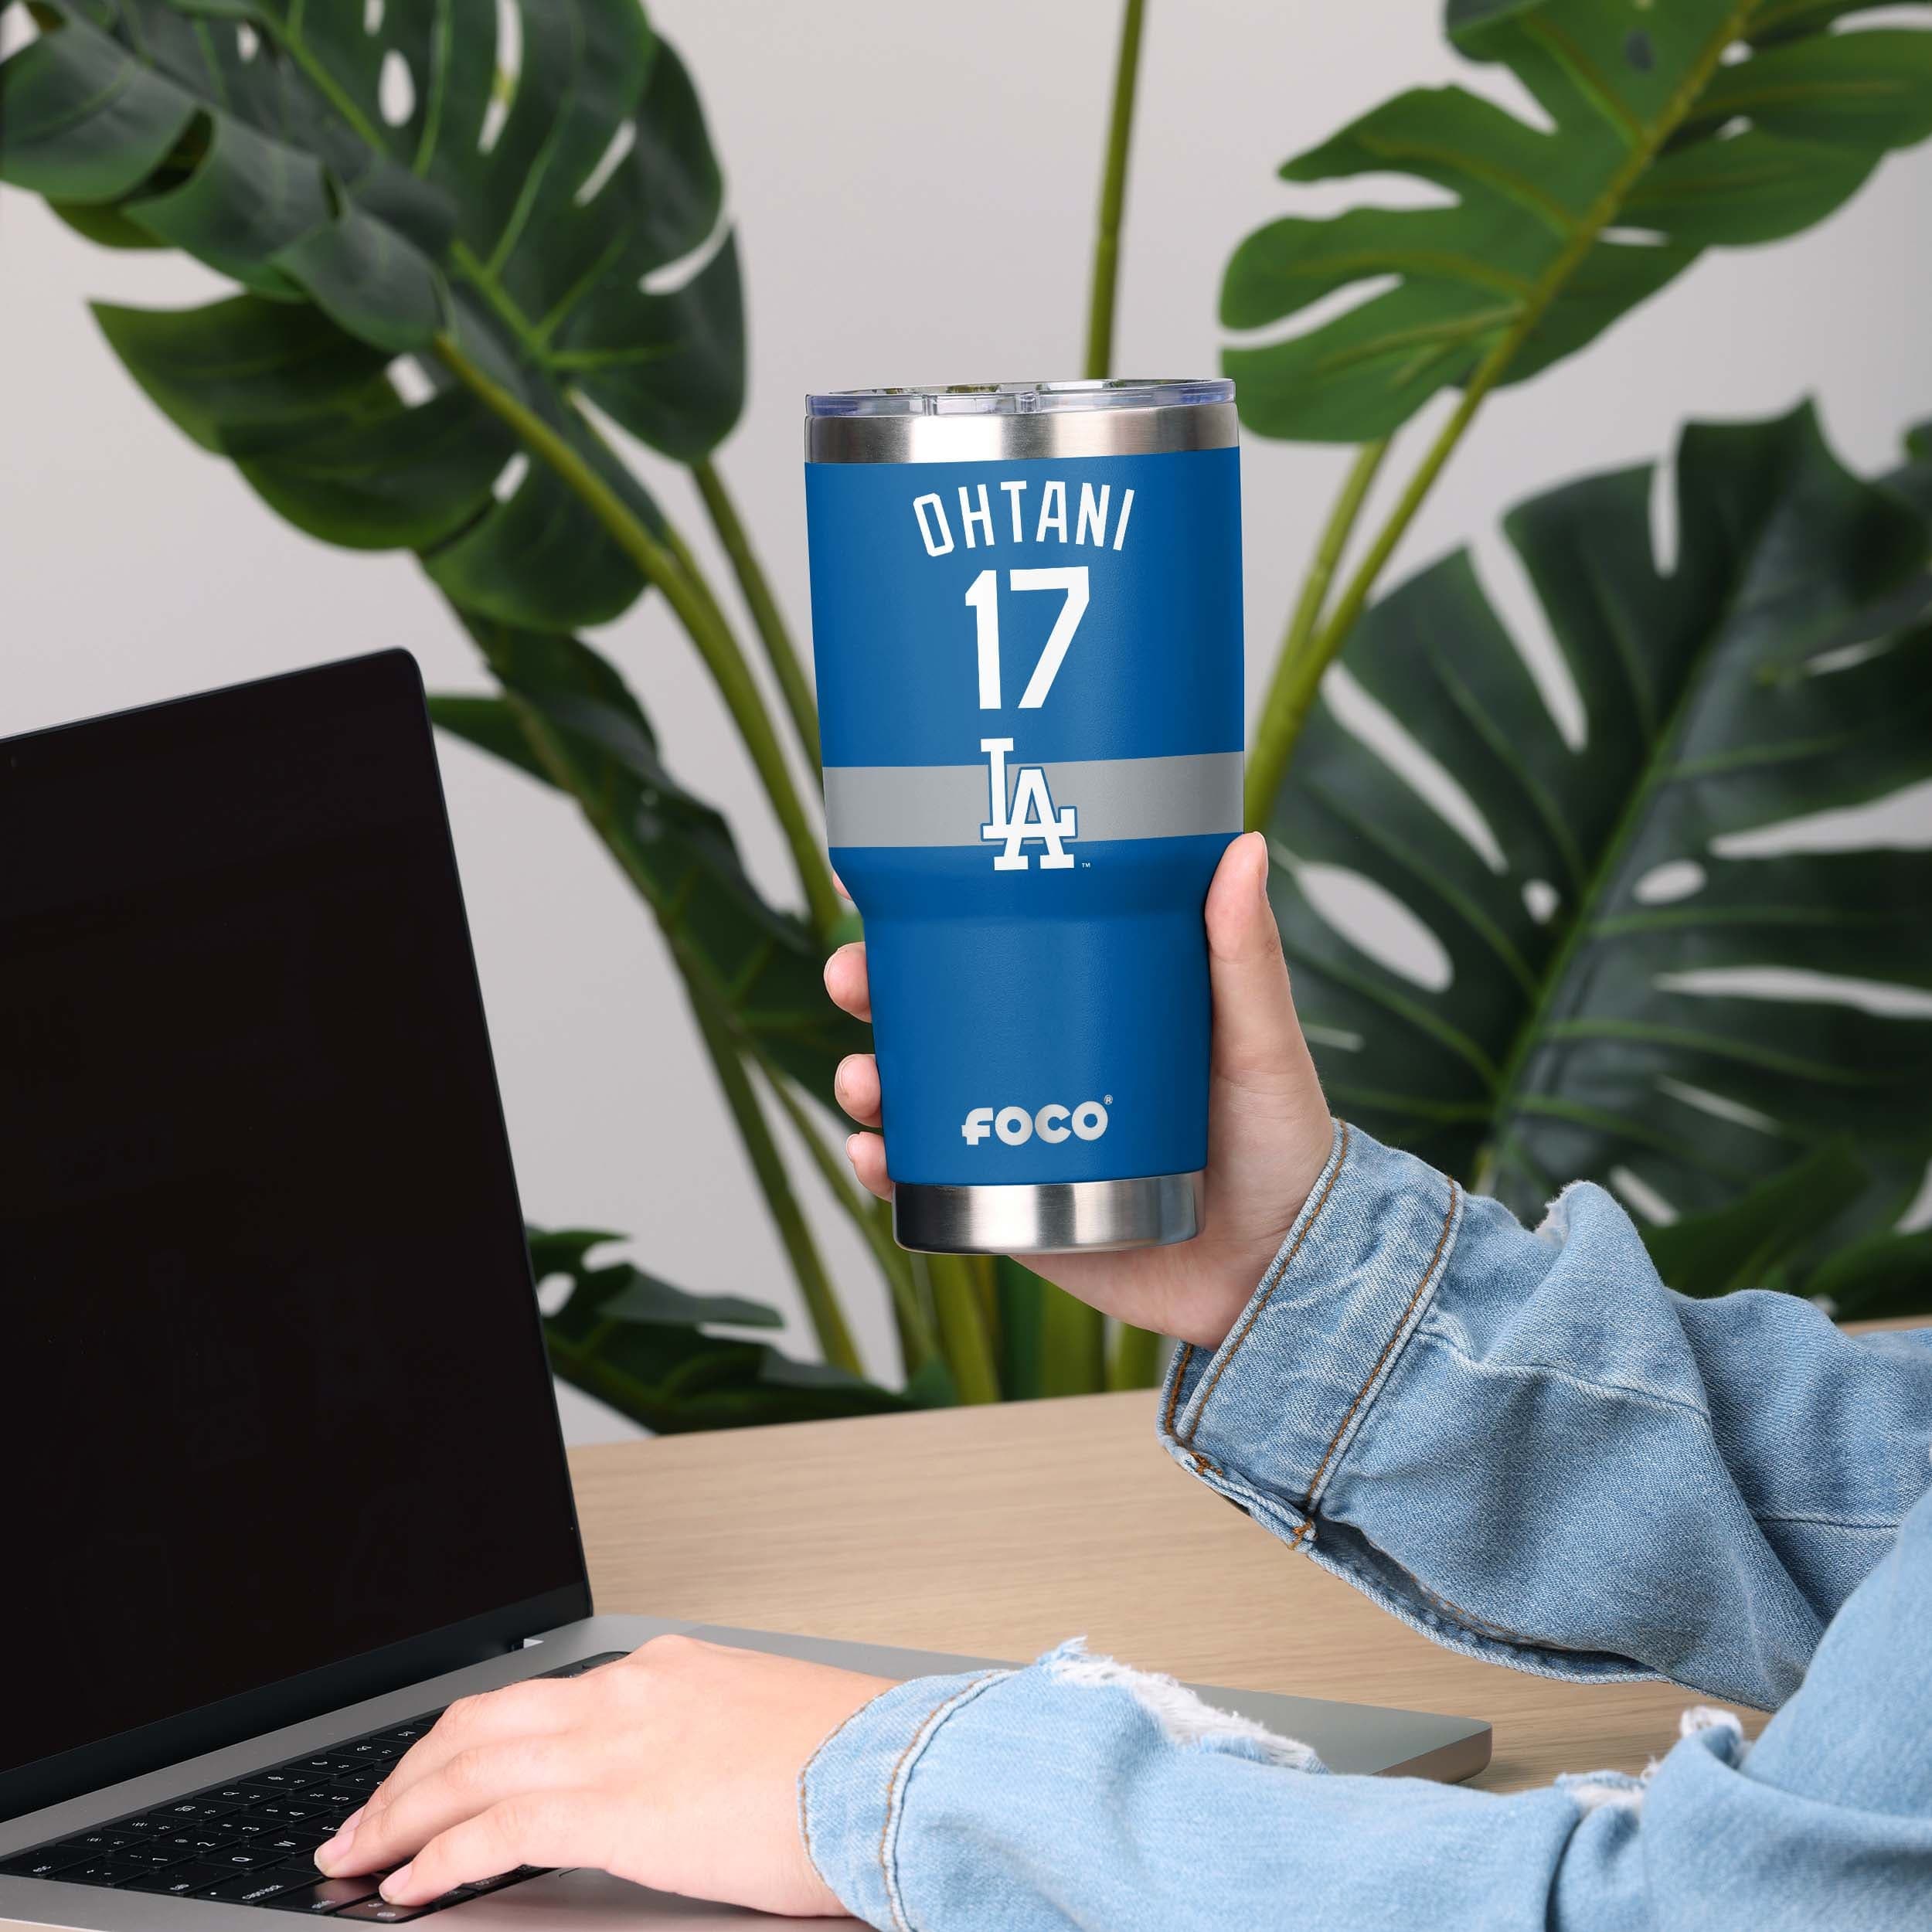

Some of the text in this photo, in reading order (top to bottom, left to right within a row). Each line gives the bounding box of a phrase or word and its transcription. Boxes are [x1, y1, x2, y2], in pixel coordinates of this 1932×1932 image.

[913, 480, 1135, 557] OHTANI
[965, 566, 1090, 709] 17
[980, 737, 1077, 870] LA
[961, 1100, 1108, 1146] FOCO
